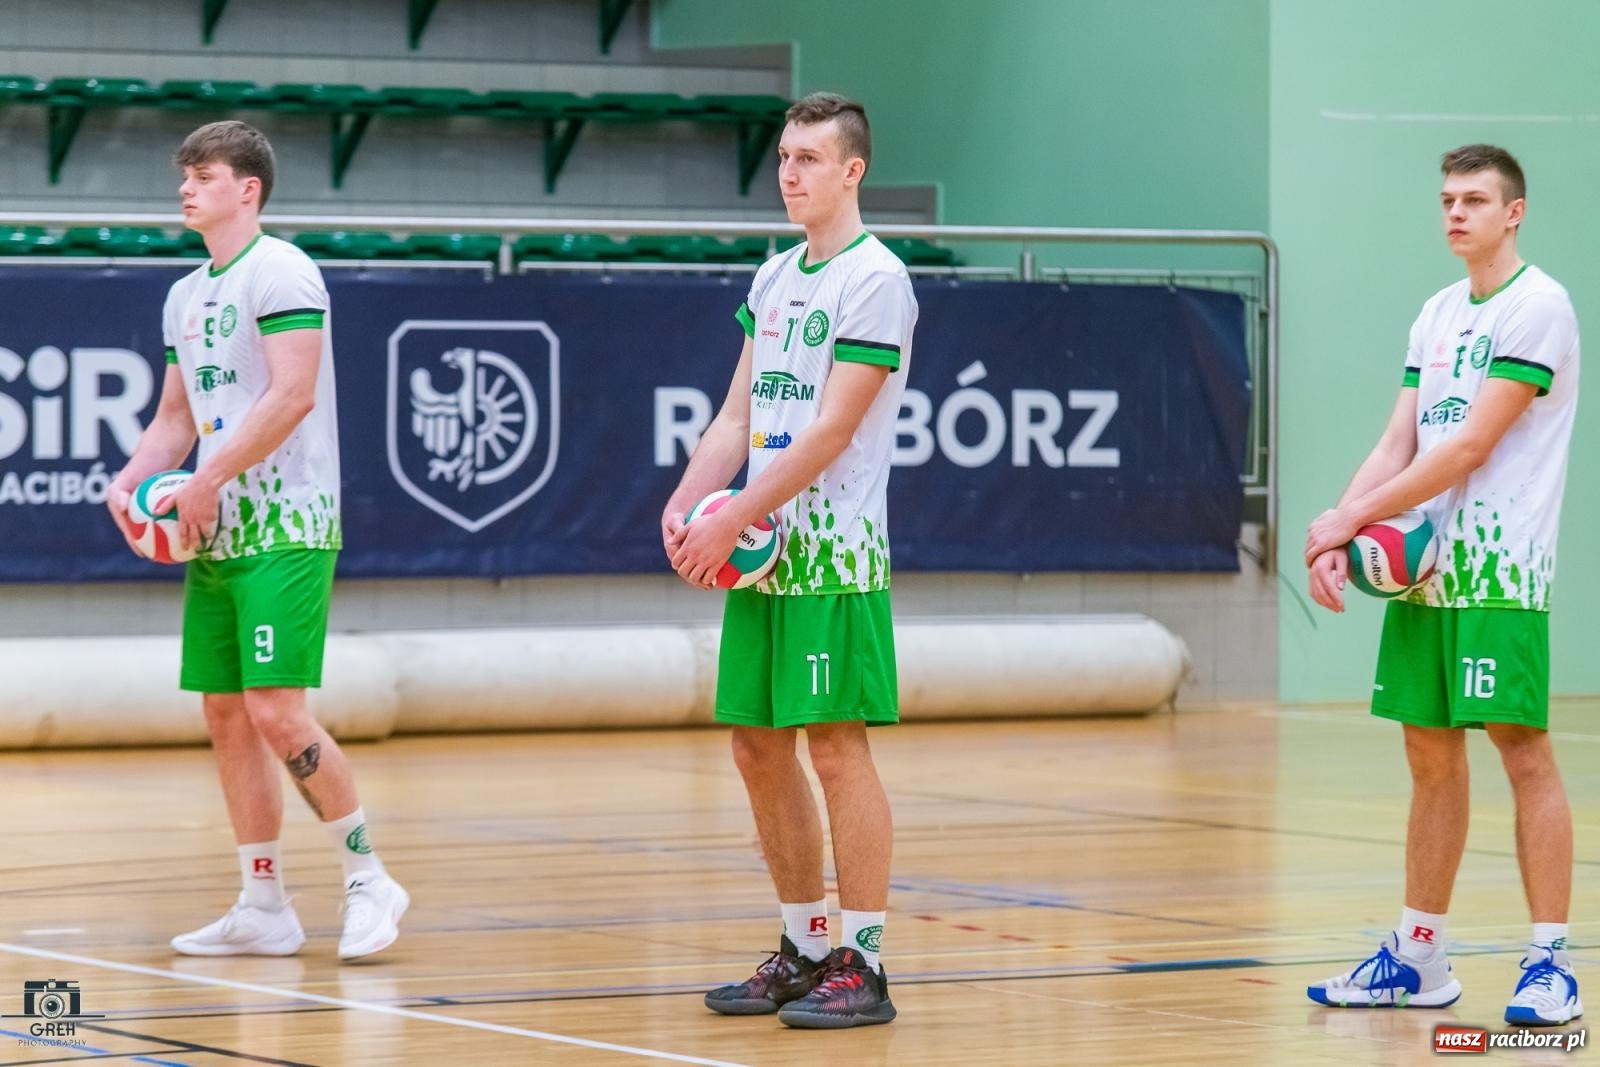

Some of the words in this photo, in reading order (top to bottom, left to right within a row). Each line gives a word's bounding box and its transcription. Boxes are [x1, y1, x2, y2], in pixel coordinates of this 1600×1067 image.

[654, 359, 1120, 468] RBÓRZ
[0, 461, 119, 505] ACIBÓ
[1370, 546, 1383, 586] molten
[255, 624, 274, 663] 9
[806, 652, 830, 696] 11
[1462, 657, 1496, 699] 16
[253, 857, 274, 874] R
[809, 916, 828, 932] R
[1412, 925, 1434, 941] R
